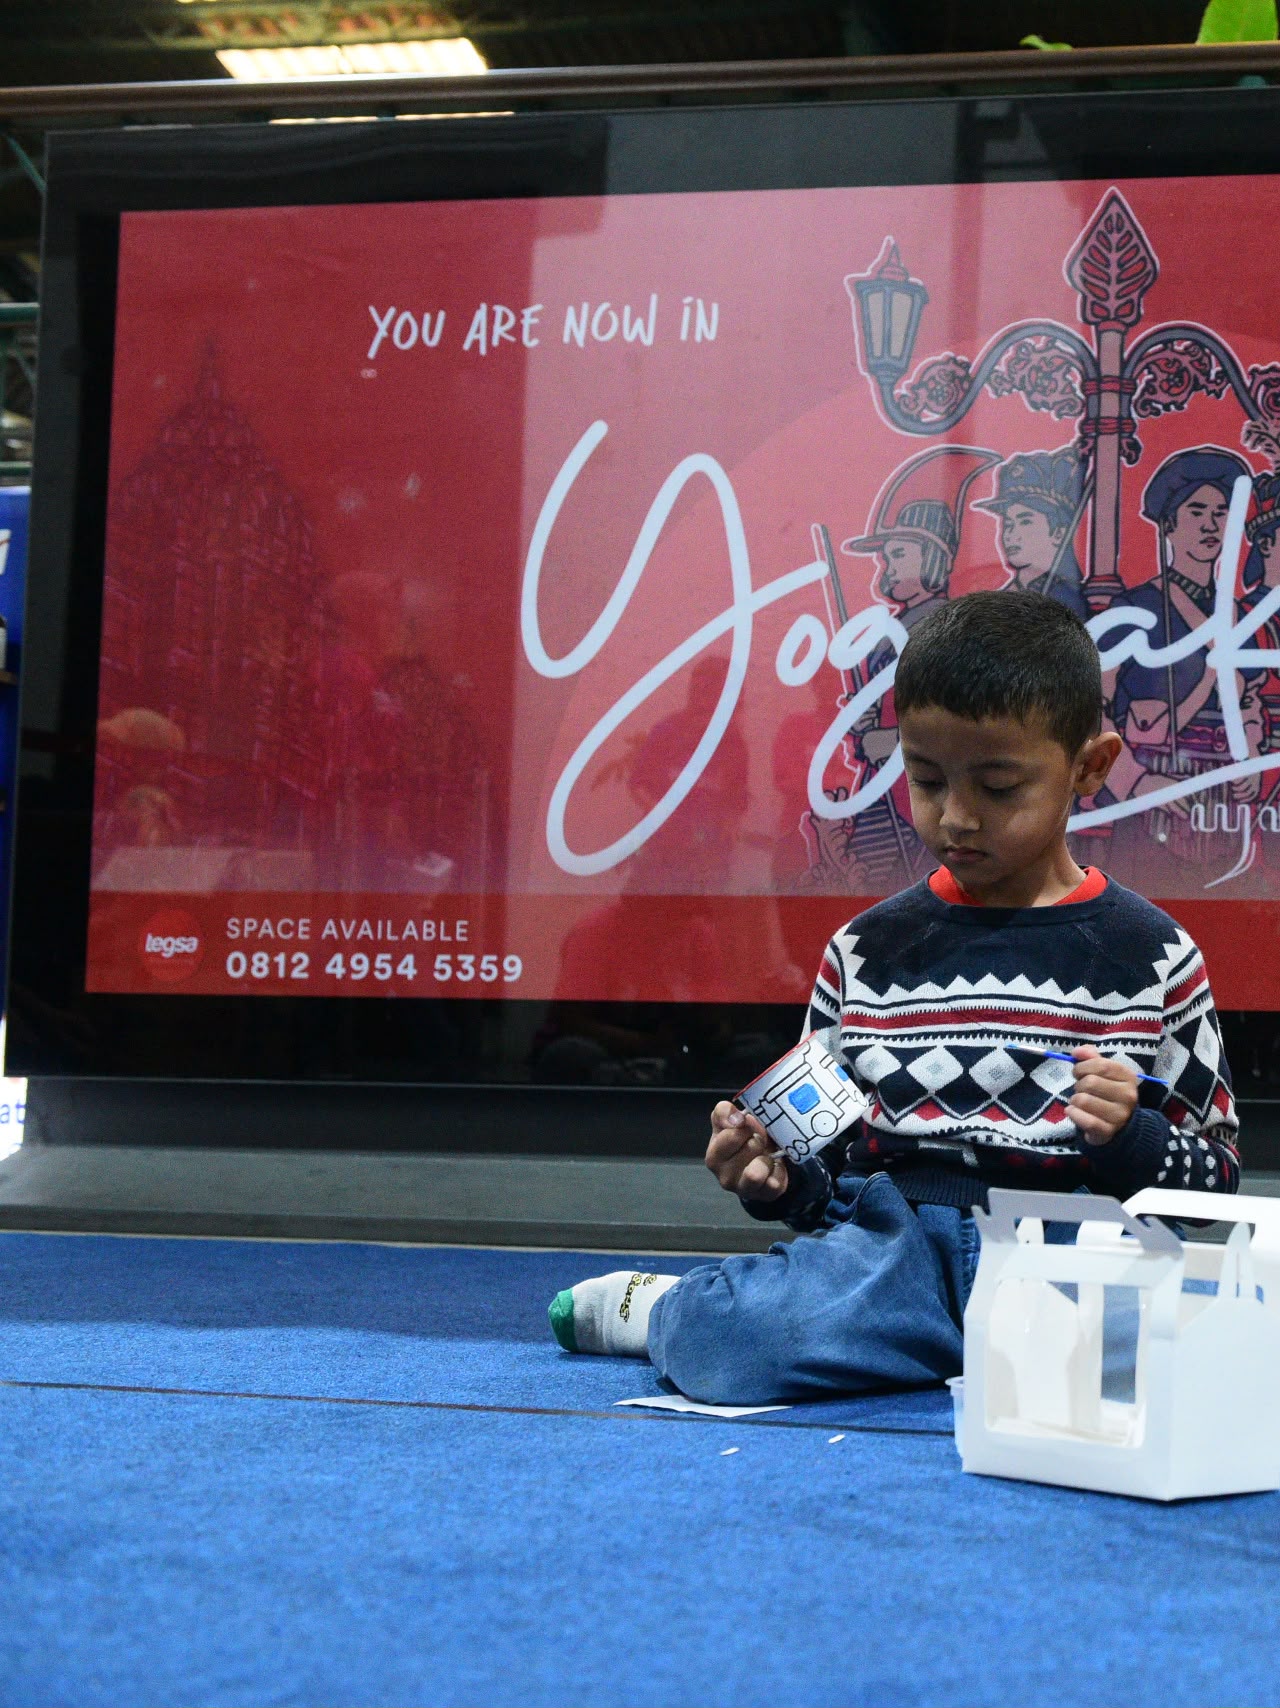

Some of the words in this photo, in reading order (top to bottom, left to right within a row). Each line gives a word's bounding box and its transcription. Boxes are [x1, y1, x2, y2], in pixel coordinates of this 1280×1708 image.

[368, 305, 446, 360] YOU
[463, 302, 544, 356] ARE
[562, 293, 657, 348] NOW
[226, 918, 311, 940] SPACE
[321, 919, 469, 942] AVAILABLE
[225, 951, 311, 979] 0812
[325, 952, 417, 981] 4954
[433, 954, 523, 983] 5359
